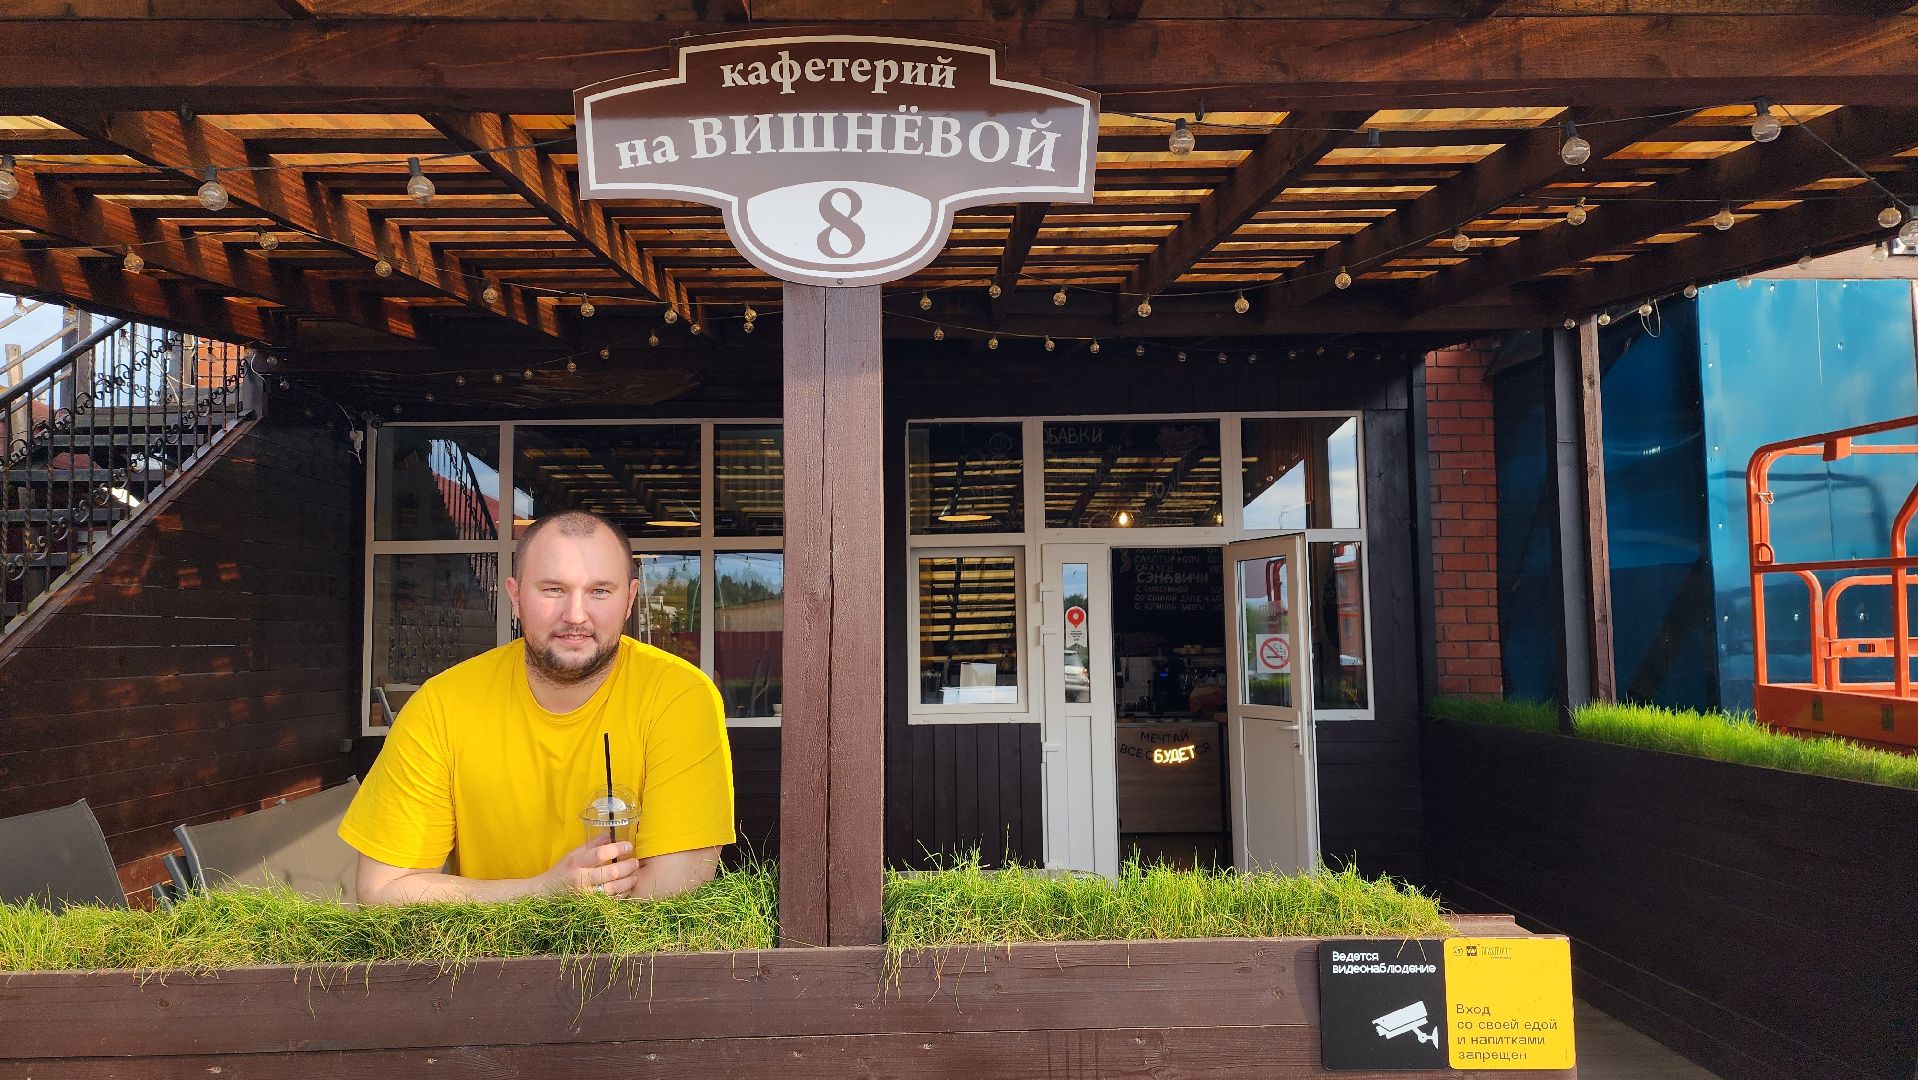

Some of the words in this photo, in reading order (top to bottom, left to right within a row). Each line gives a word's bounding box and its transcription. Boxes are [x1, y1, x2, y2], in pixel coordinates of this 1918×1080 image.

[720, 51, 957, 94] кафетерий
[615, 134, 680, 169] на
[688, 104, 1062, 173] ВИШНЁВОЙ
[816, 187, 866, 259] 8
[1043, 426, 1103, 445] ОБАВКИ
[1140, 730, 1189, 743] МЕЧТАЙ
[1119, 743, 1143, 758] ВСЕ
[1332, 950, 1379, 962] Ведется
[1332, 962, 1437, 975] видеонаблюдение
[1456, 1003, 1491, 1017] Вход
[1457, 1021, 1473, 1030] со
[1478, 1018, 1519, 1030] своей
[1524, 1019, 1558, 1031] едой
[1457, 1036, 1466, 1045] и
[1470, 1036, 1545, 1045] напитками
[1458, 1051, 1527, 1062] запрещен
